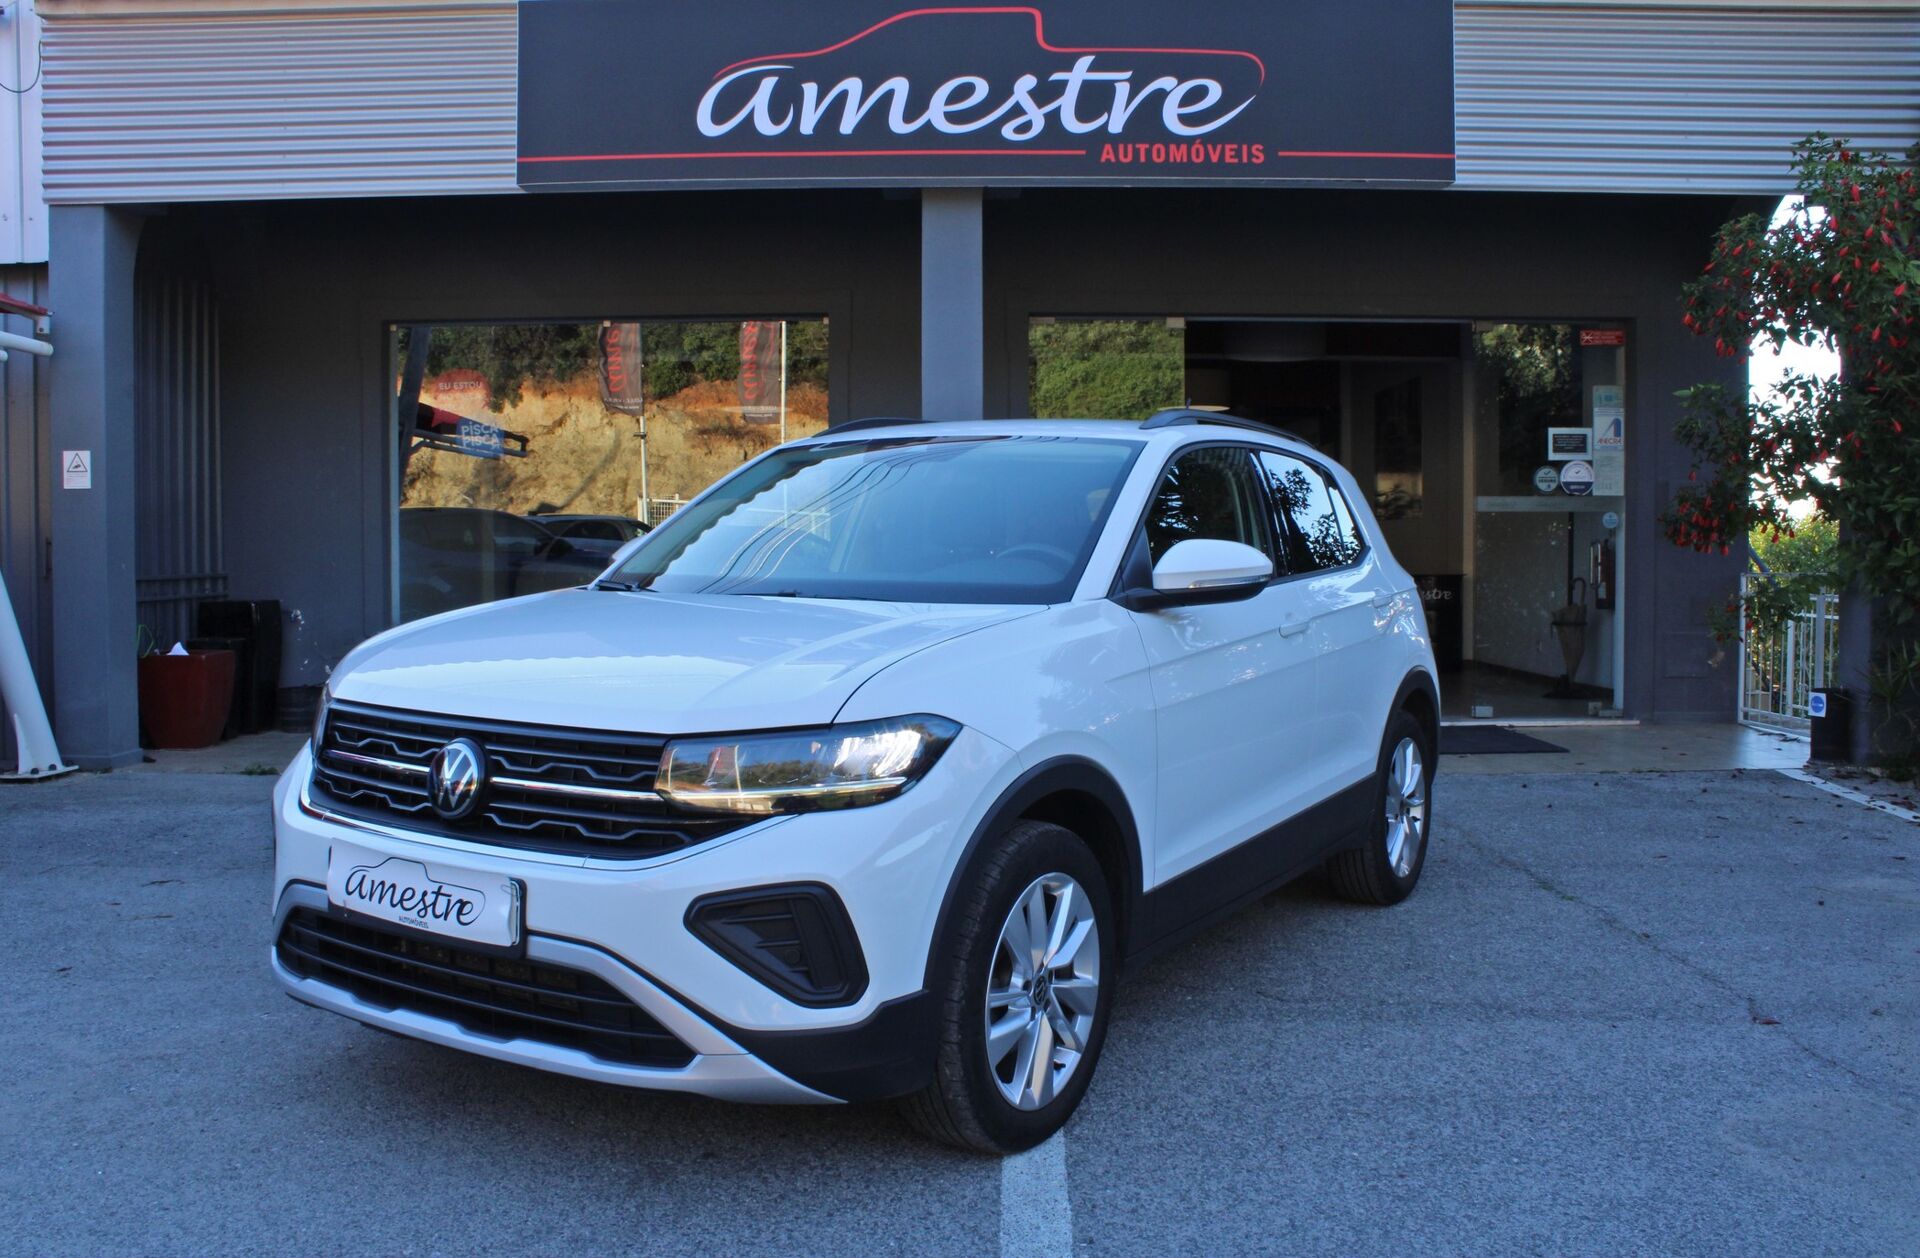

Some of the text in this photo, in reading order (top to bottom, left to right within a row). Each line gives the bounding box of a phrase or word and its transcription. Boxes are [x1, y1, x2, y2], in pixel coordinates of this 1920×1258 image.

[696, 55, 1257, 141] amestre
[1100, 141, 1266, 164] AUTOMÓVEIS
[345, 869, 474, 926] amestre
